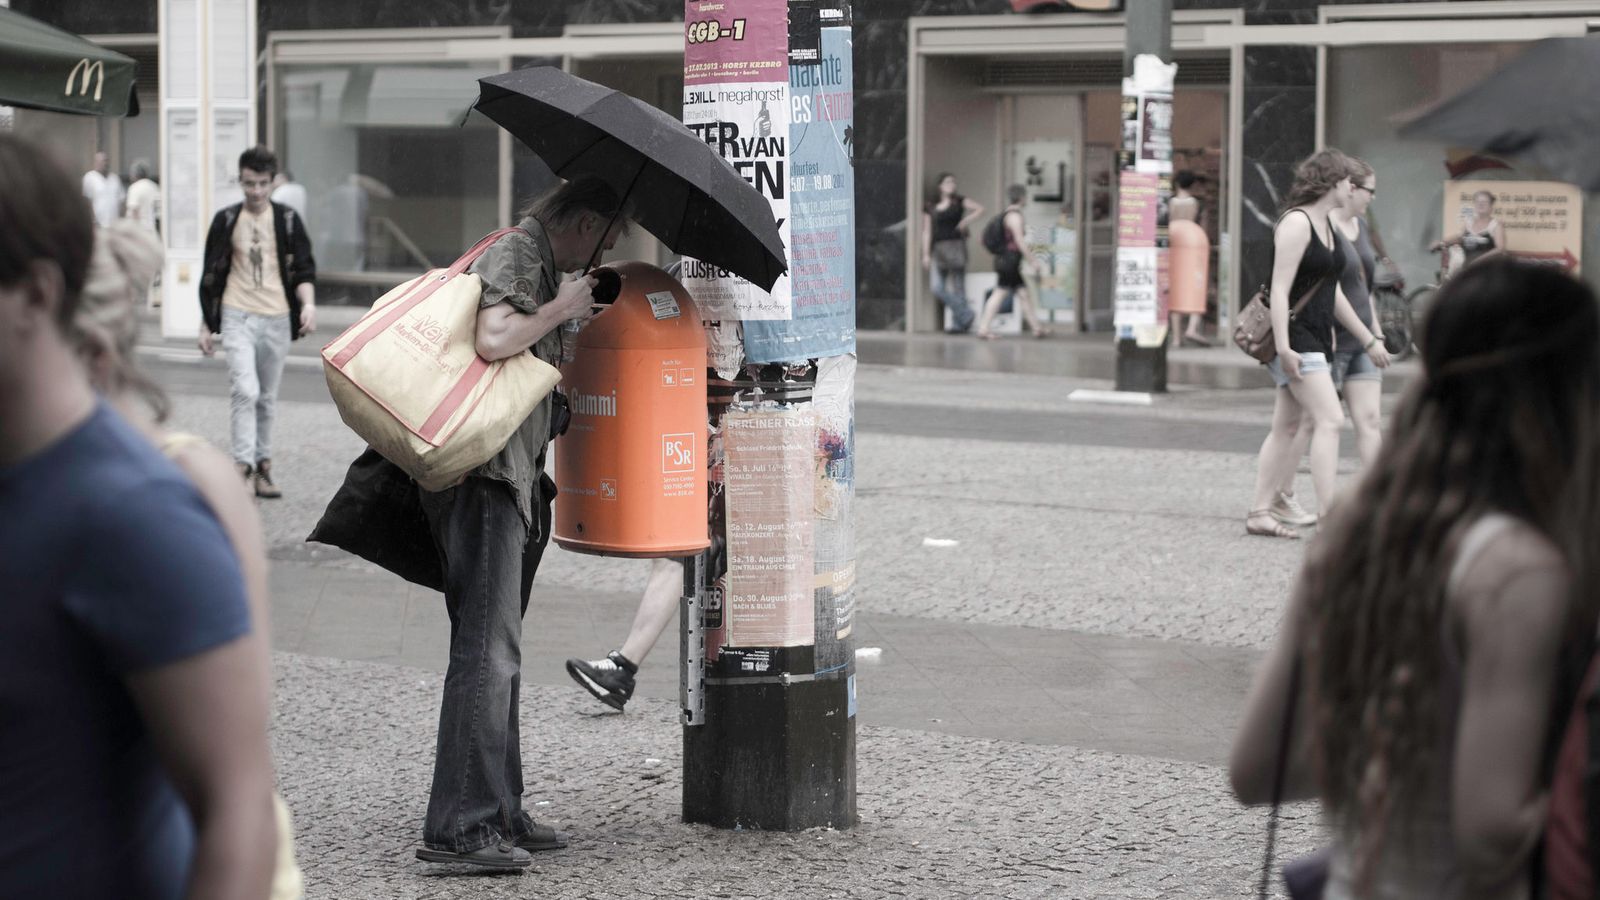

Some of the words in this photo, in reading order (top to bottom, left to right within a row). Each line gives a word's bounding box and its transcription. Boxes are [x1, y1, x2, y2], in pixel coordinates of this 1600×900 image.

[722, 61, 748, 69] HORST
[718, 86, 784, 105] megahorst!
[741, 137, 785, 158] VAN
[571, 387, 617, 417] Gummi
[666, 441, 692, 465] BSR
[729, 465, 741, 473] So.
[751, 464, 766, 472] Juli
[601, 482, 615, 497] BSR
[758, 522, 784, 532] August
[759, 554, 785, 563] August
[733, 594, 745, 602] Do.
[747, 594, 758, 602] 30.
[760, 593, 787, 603] August
